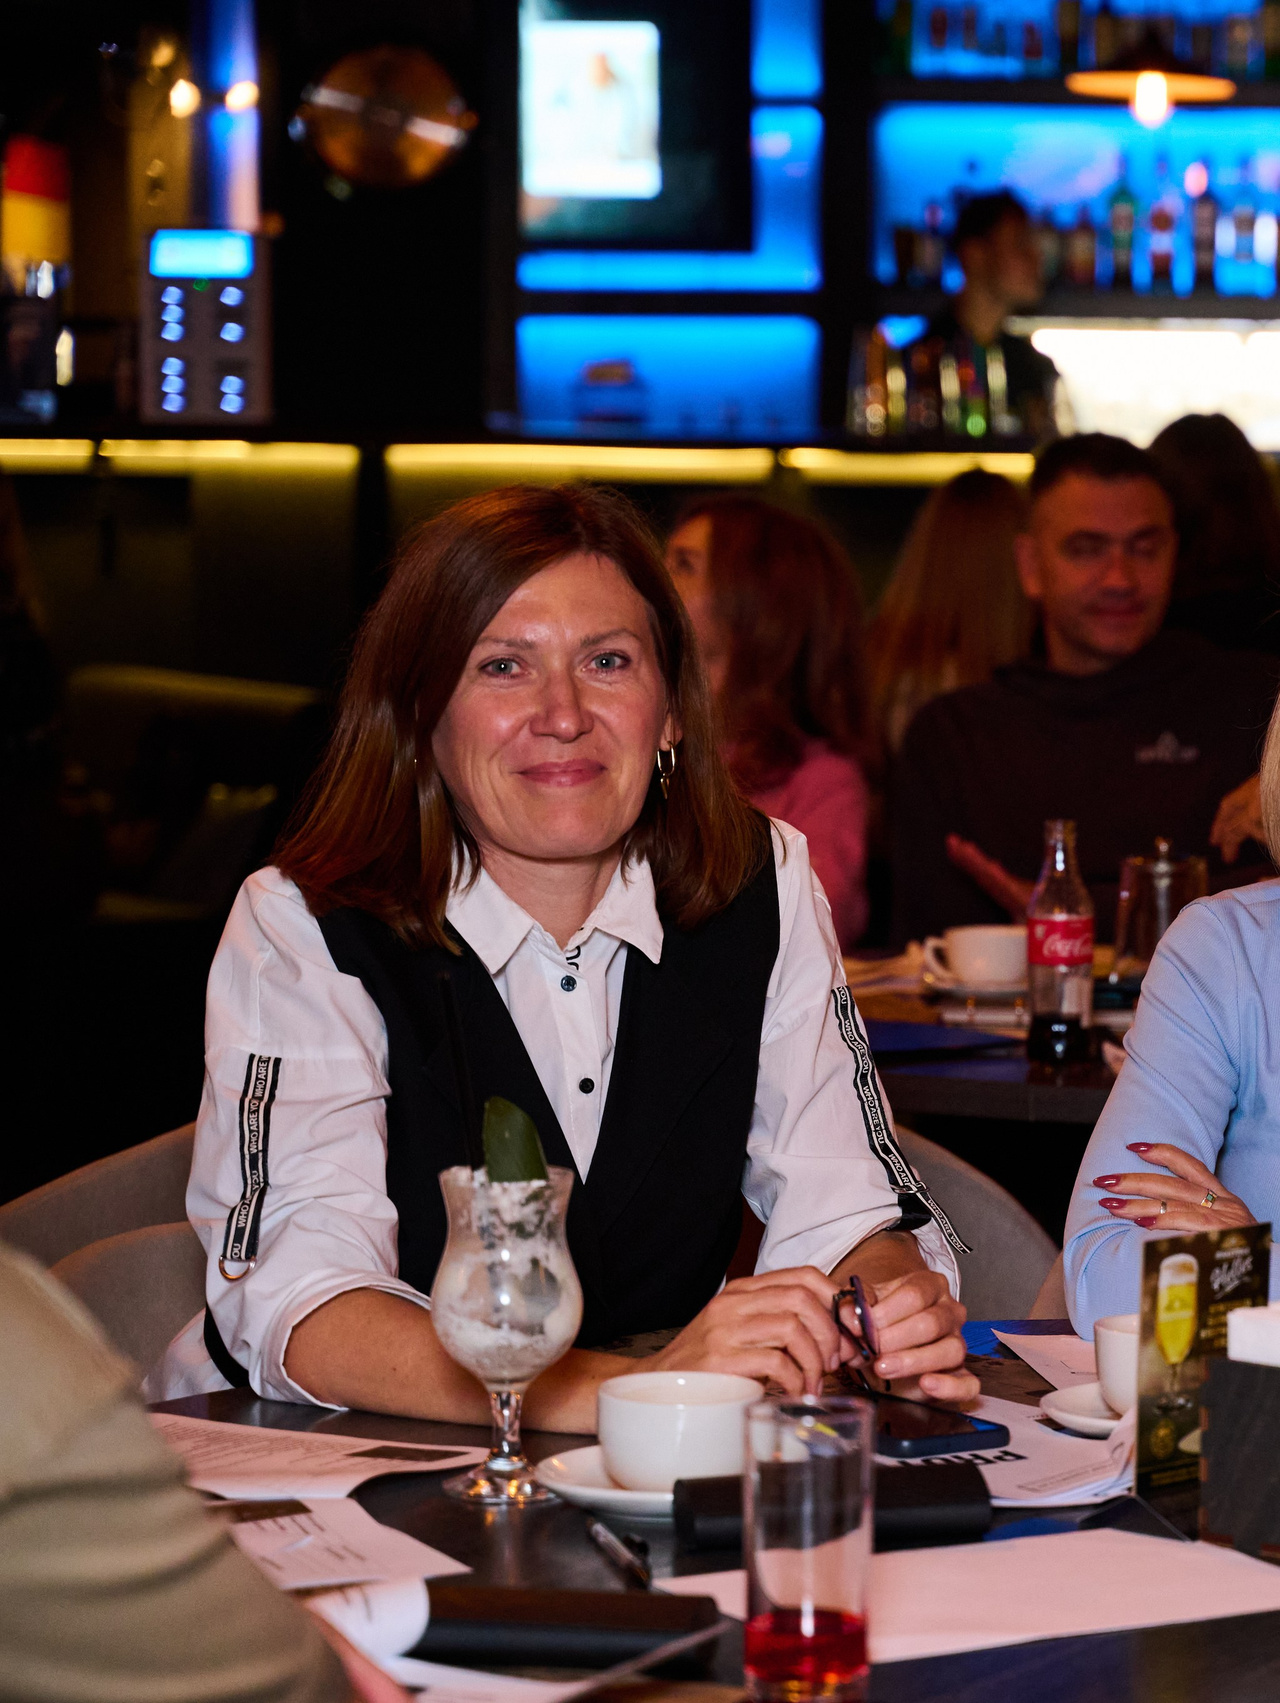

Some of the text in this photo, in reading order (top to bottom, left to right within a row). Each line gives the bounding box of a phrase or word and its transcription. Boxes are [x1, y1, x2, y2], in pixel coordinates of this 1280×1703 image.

[845, 1019, 855, 1041] WHO
[258, 1061, 268, 1080] ARE
[254, 1080, 266, 1097] WHO
[863, 1085, 885, 1144] WHO ARE YOU
[249, 1099, 259, 1154] WHO ARE YO
[888, 1153, 903, 1172] WHO
[237, 1204, 249, 1228] WHO
[252, 1170, 260, 1191] YOU
[927, 1199, 964, 1251] WHO ARE YOU
[231, 1243, 242, 1259] OU
